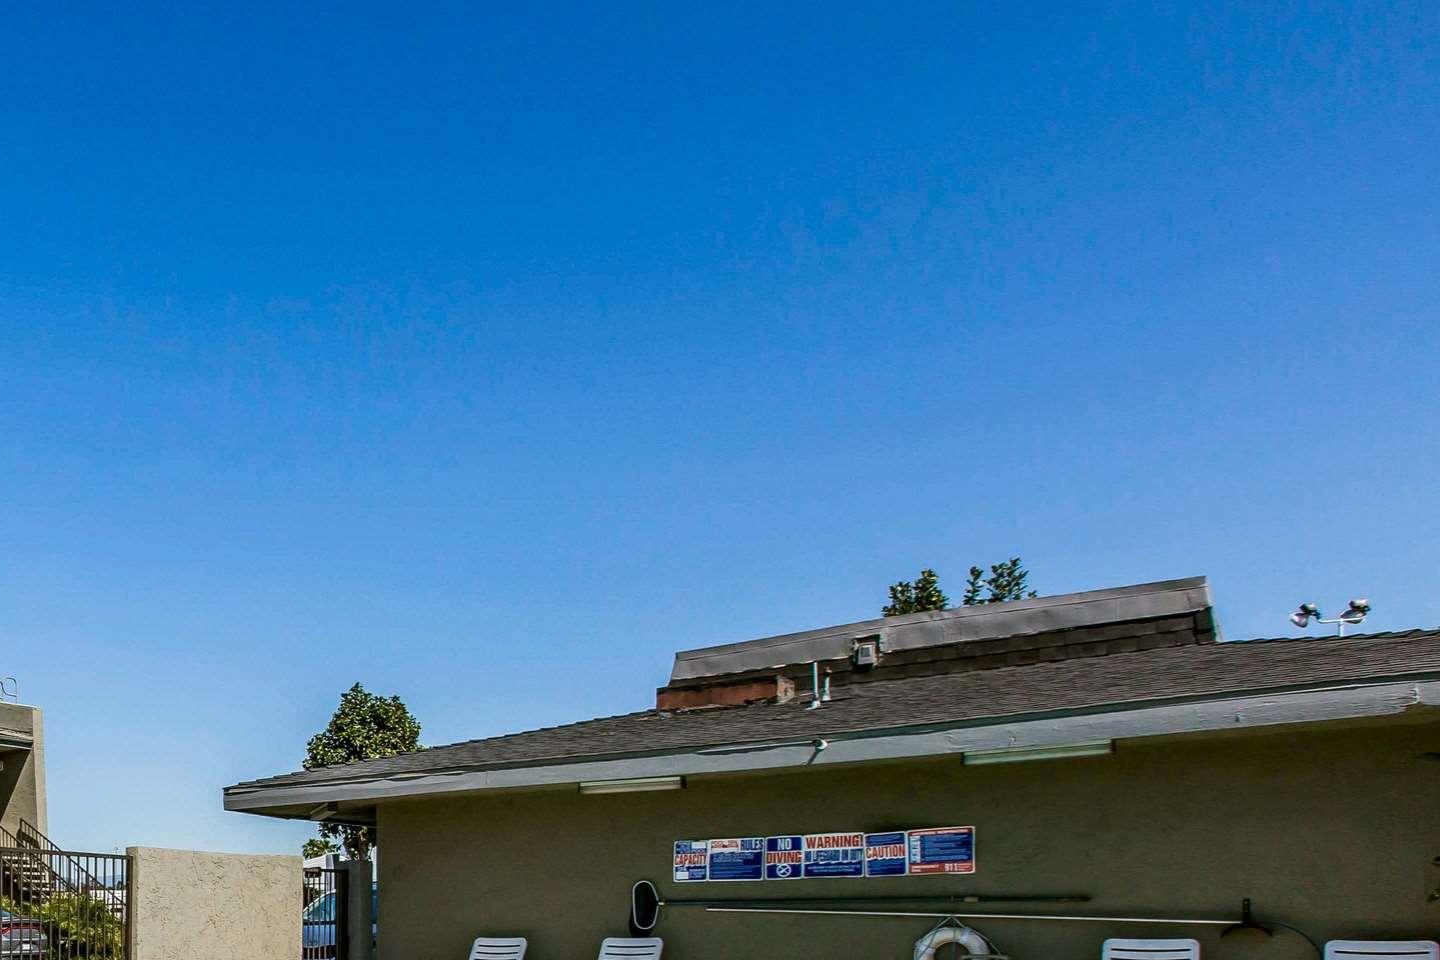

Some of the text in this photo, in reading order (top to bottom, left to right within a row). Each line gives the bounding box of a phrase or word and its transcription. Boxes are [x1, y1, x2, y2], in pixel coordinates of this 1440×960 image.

[777, 838, 792, 850] NO
[767, 851, 802, 864] DIVING
[866, 844, 905, 858] CAUTION
[675, 853, 707, 866] CAPACITY
